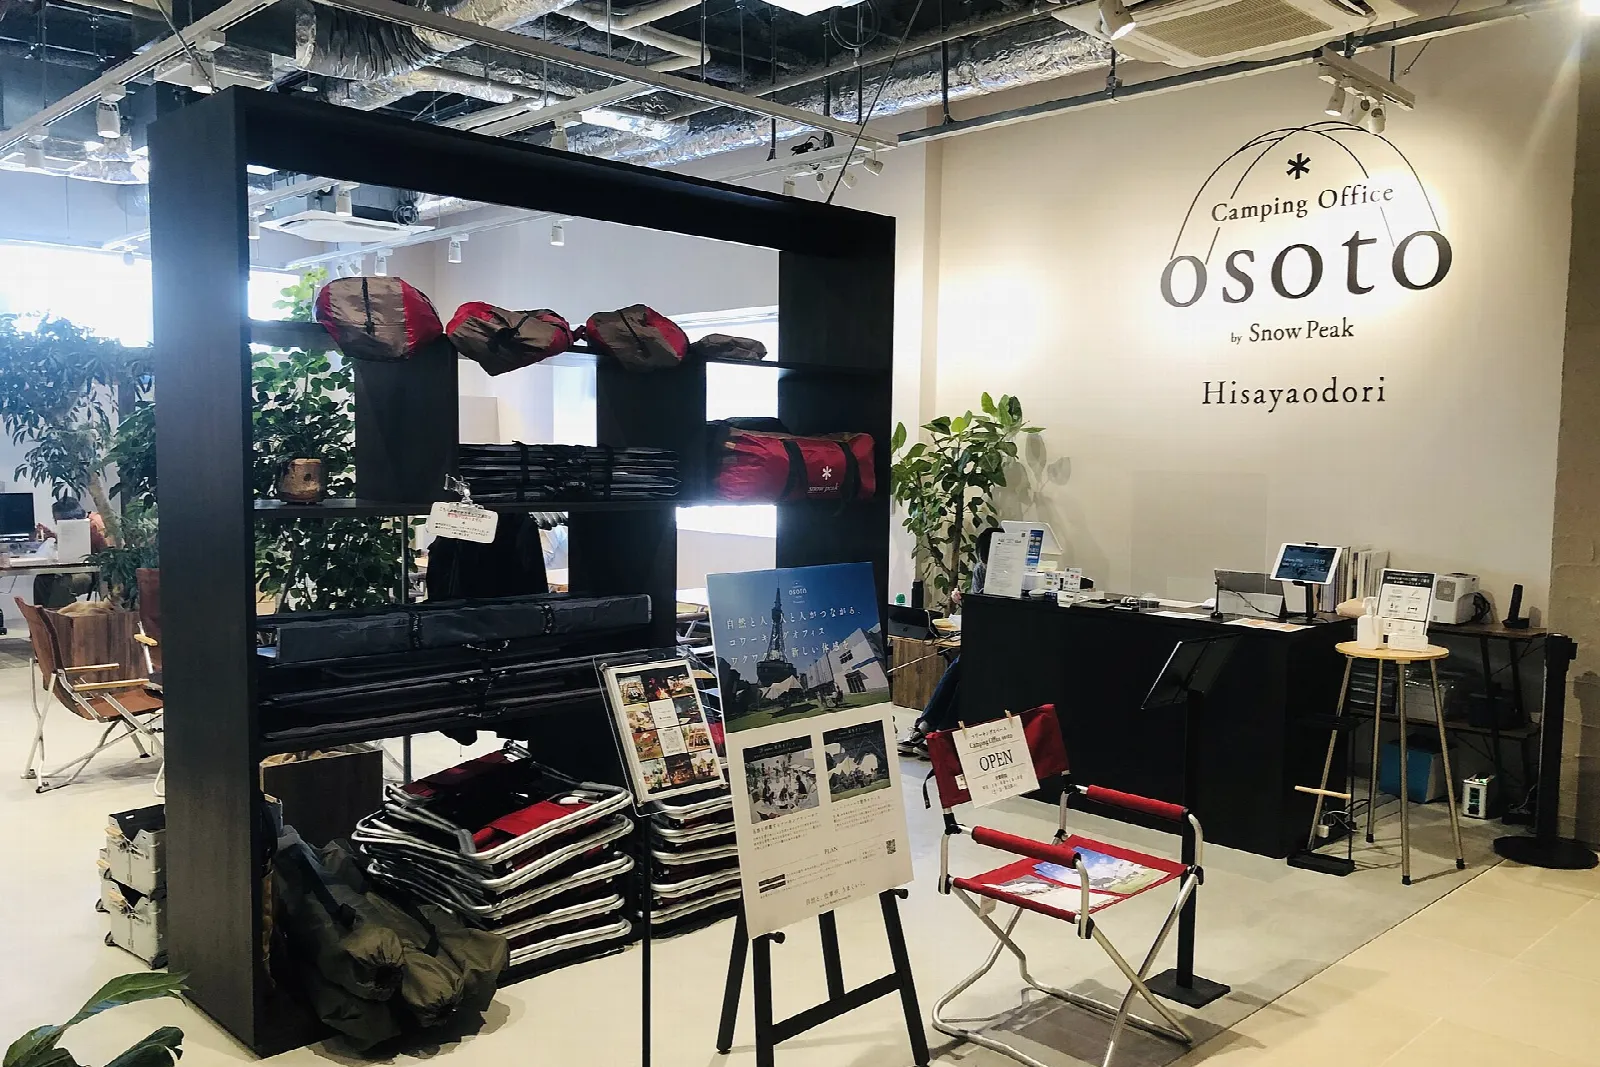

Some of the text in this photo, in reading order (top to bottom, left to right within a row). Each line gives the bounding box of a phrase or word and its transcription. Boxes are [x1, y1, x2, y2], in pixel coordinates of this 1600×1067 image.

[1211, 184, 1394, 223] Camping Office
[1160, 230, 1453, 308] osoto
[1230, 317, 1355, 345] by Snow Peak
[1201, 376, 1386, 413] Hisayaodori
[824, 483, 839, 492] peak
[979, 749, 1013, 771] OPEN
